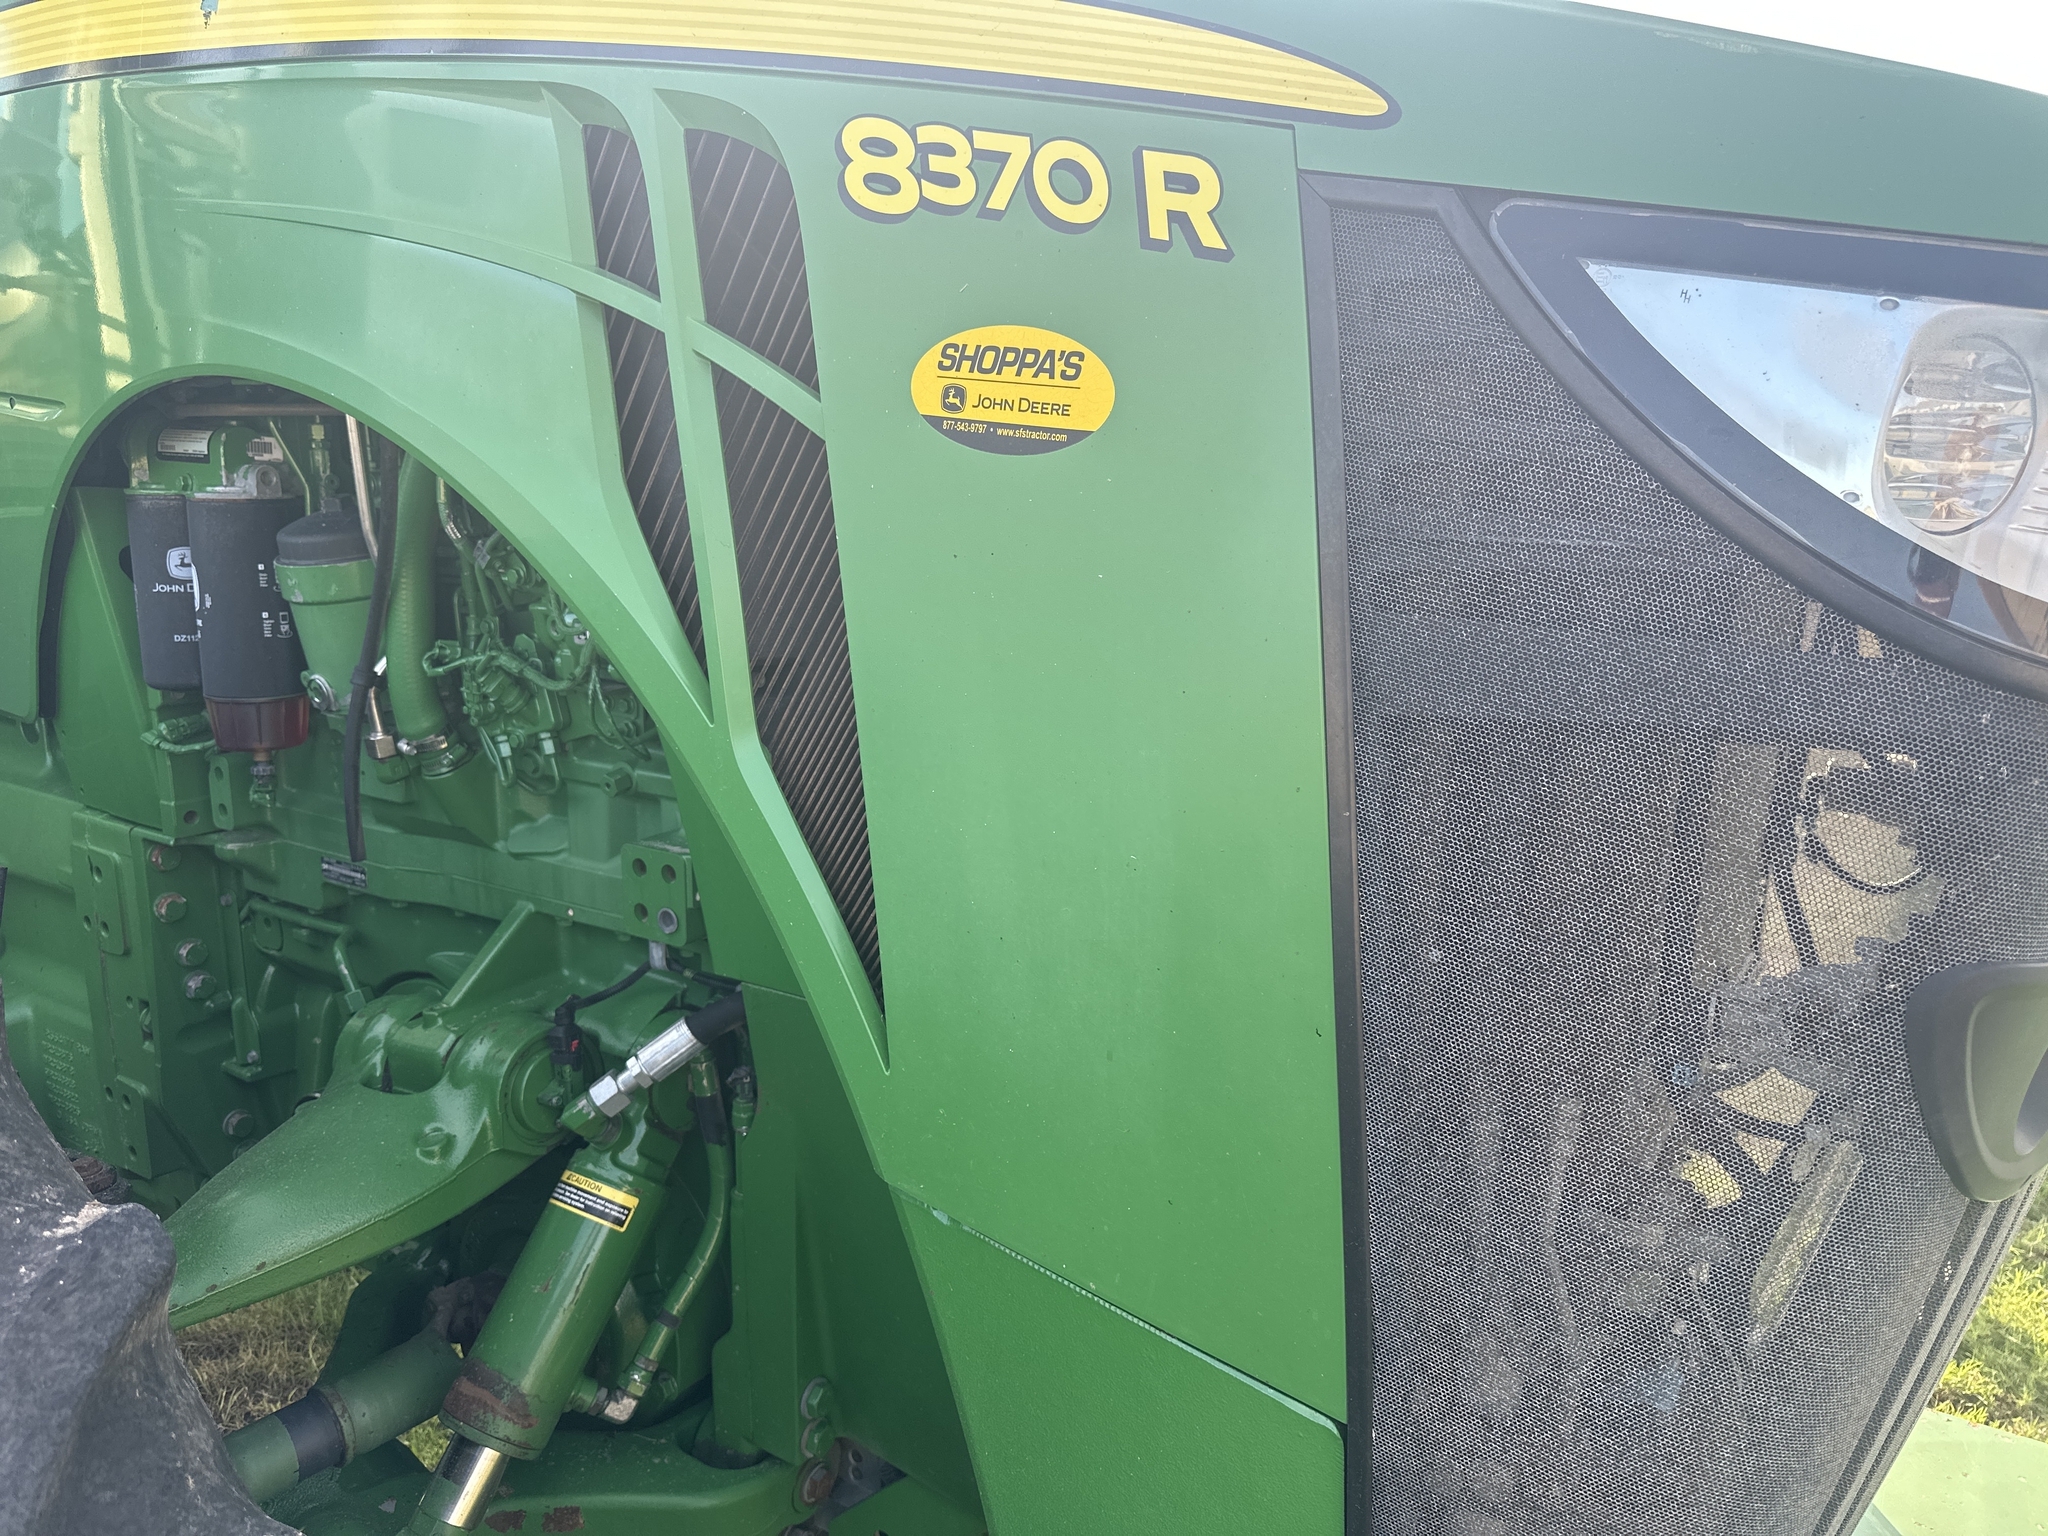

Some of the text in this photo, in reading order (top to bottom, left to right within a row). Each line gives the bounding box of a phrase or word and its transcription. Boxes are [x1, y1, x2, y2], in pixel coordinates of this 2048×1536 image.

[837, 114, 1235, 262] 8370 R
[937, 342, 1085, 381] SHOPPA'S
[972, 394, 1072, 417] JOHN DEERE
[942, 420, 1068, 442] 877-543-9797 www.sfstractor.com
[152, 583, 185, 593] JOHN
[570, 1174, 603, 1193] CAUTION
